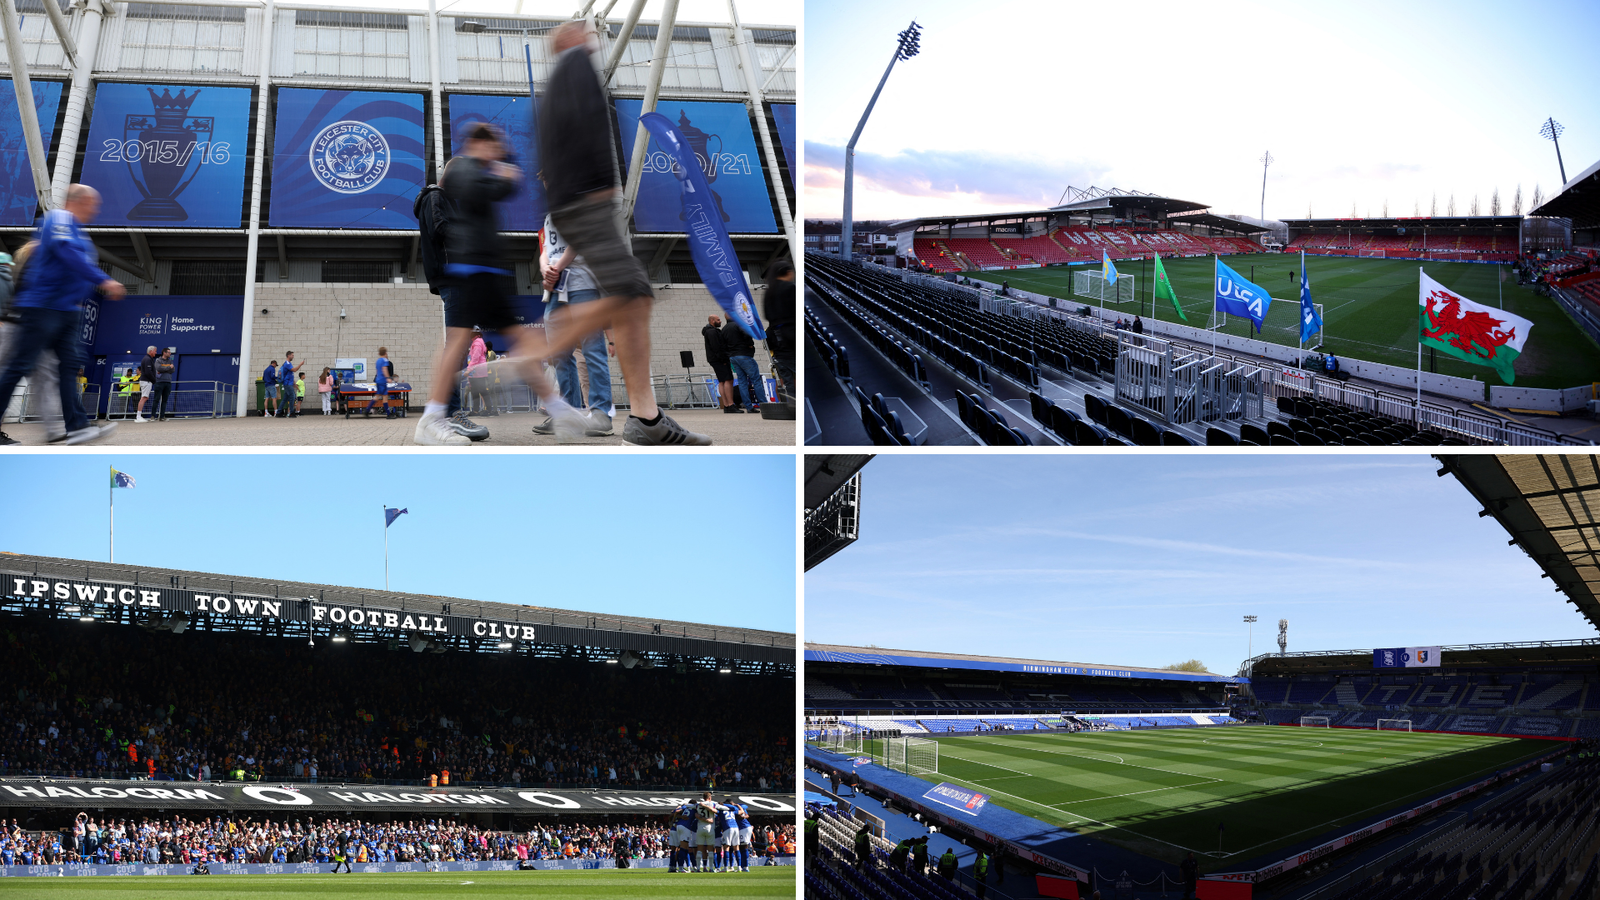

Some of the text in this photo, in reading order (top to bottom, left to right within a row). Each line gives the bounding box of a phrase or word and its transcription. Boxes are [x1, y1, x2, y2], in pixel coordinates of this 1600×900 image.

[316, 125, 385, 155] LEICESTER CITY
[100, 138, 231, 167] 2015/16
[315, 158, 385, 189] FOOTBALL CLUB
[686, 203, 738, 288] FAMILY
[84, 304, 97, 322] 50
[171, 316, 194, 324] Home
[82, 323, 94, 341] 51
[171, 324, 215, 332] Supporters
[13, 578, 535, 640] IPSWICH TOWN FOOTBALL CLUB
[1023, 665, 1062, 673] BIRMINGHAM
[1091, 669, 1117, 677] FOOTBALL
[1378, 685, 1512, 704] THE
[1, 785, 225, 801] HALOCRM
[1344, 835, 1353, 845] DCE
[1298, 845, 1334, 865] DCE Exhibitions
[28, 865, 49, 874] COYB
[77, 868, 97, 876] COYB
[266, 866, 283, 874] COYB
[1032, 853, 1078, 878] DCE Exhibitions
